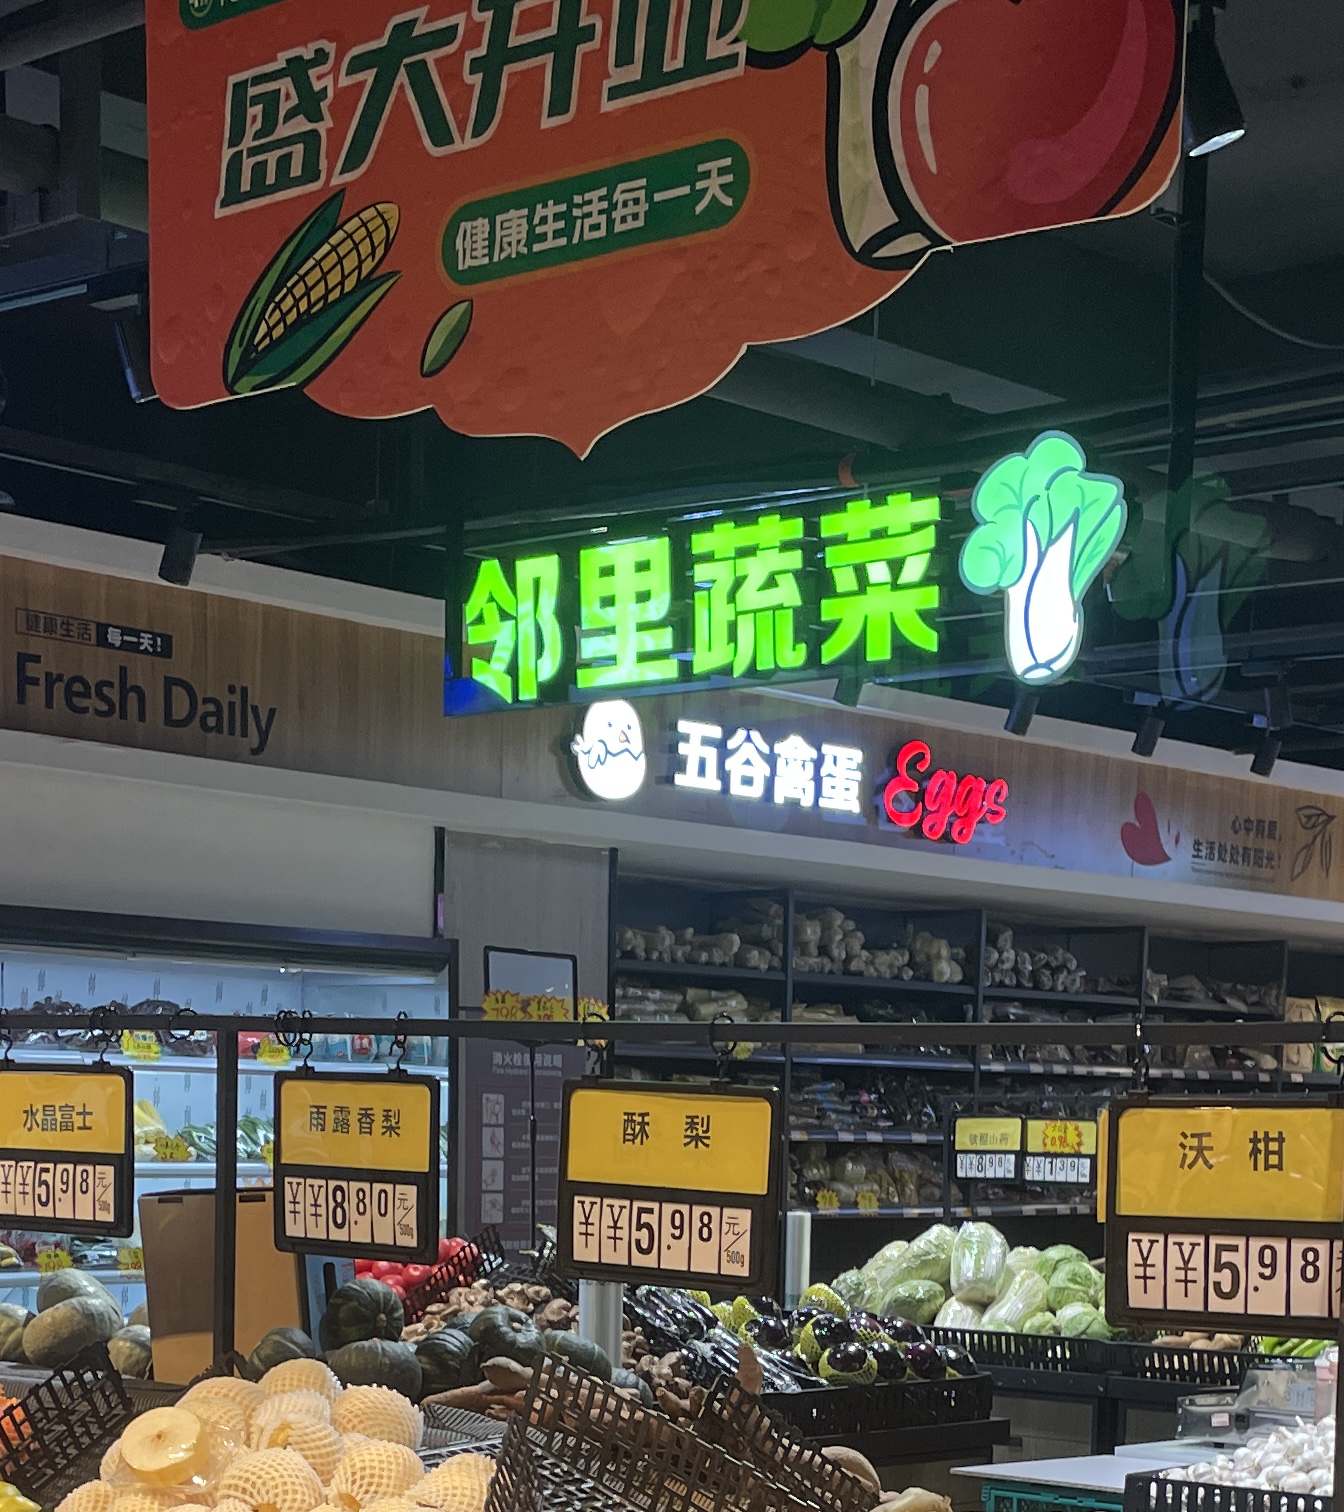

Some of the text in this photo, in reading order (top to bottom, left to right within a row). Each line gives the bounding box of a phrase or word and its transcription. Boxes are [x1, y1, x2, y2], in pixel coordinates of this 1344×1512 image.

[453, 156, 737, 272] 健康生活每一天
[25, 611, 92, 643] 健康生活
[464, 491, 942, 704] 邻里蔬菜
[15, 652, 278, 757] Fresh Daily
[673, 718, 864, 815] 五谷禽蛋
[882, 739, 1010, 846] Eggs
[21, 1102, 95, 1133] 水晶富士
[308, 1104, 402, 1139] 雨露香梨
[622, 1110, 713, 1151] 酥梨
[1177, 1128, 1287, 1173] 沃柑
